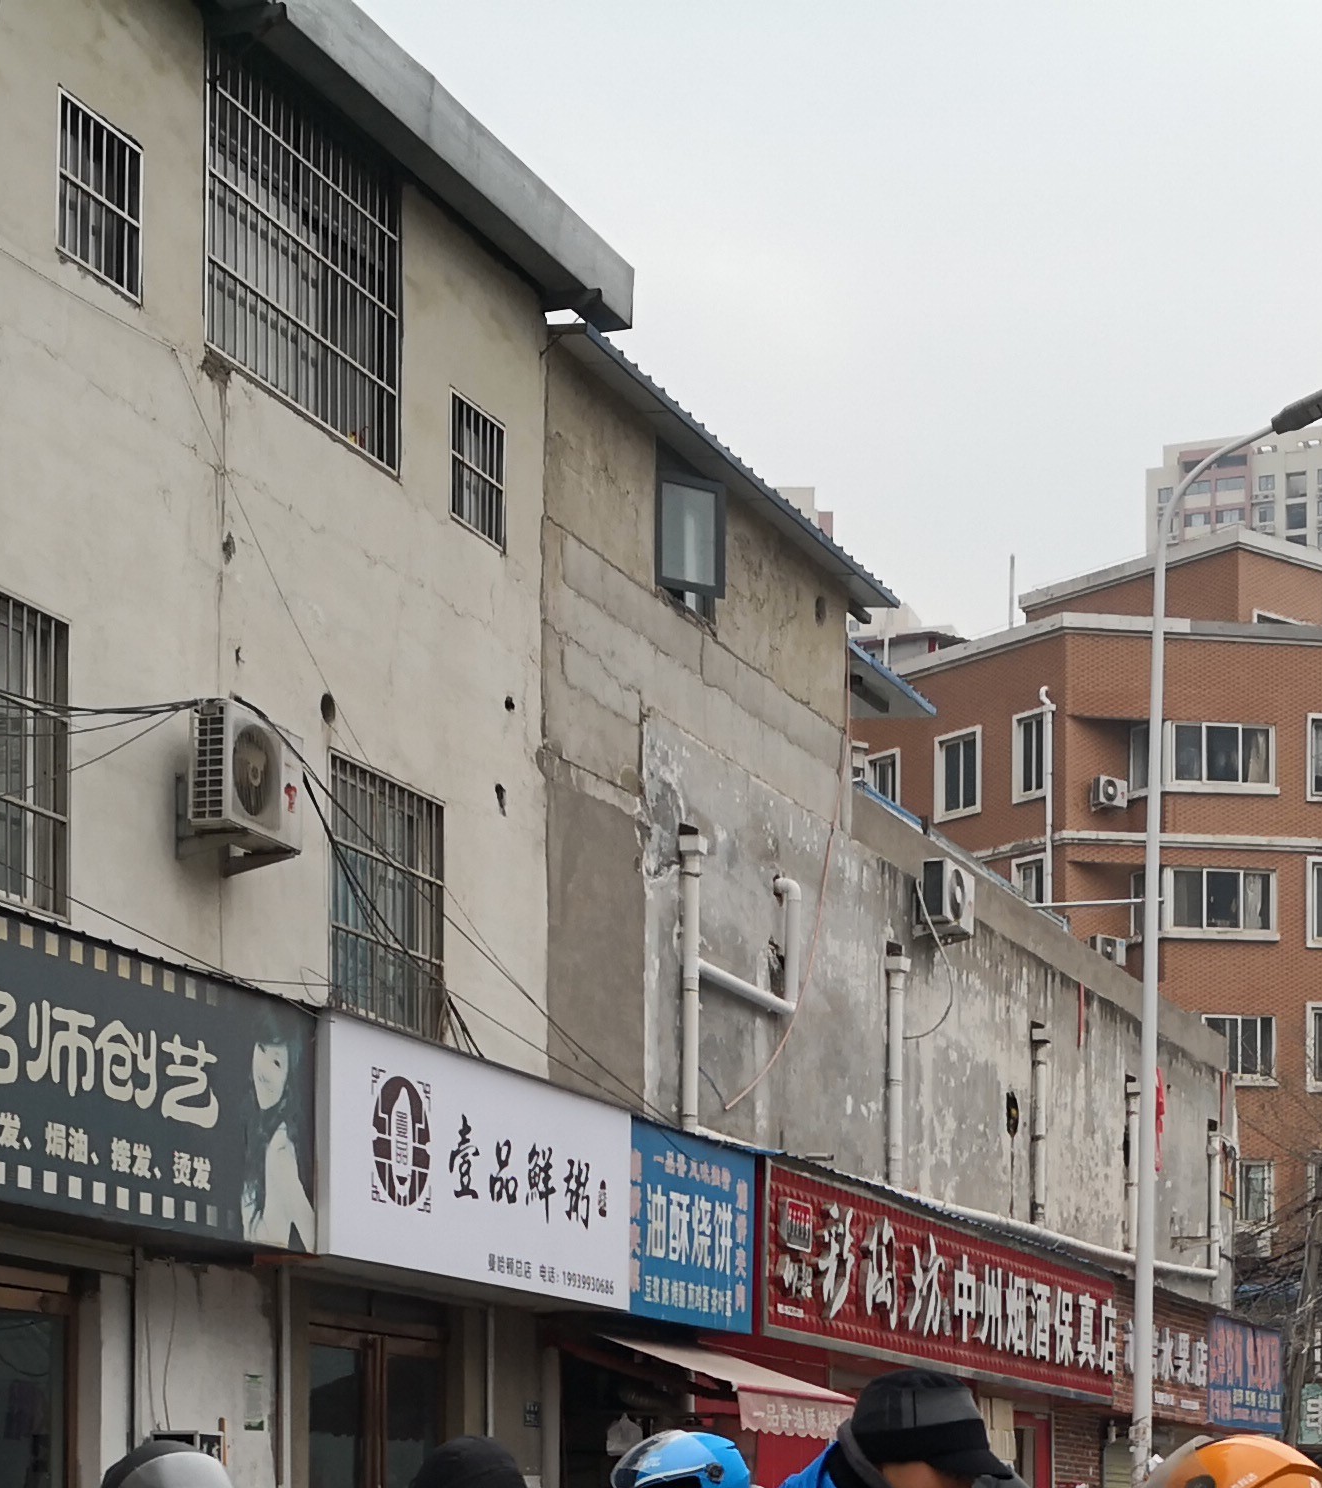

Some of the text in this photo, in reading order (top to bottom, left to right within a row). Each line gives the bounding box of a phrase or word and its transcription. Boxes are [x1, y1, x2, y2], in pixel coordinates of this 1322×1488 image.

[488, 1253, 533, 1281] 曼哈顿总店
[646, 1183, 733, 1276] 油酥烧饼
[954, 1254, 1117, 1375] 中州烟酒保真店
